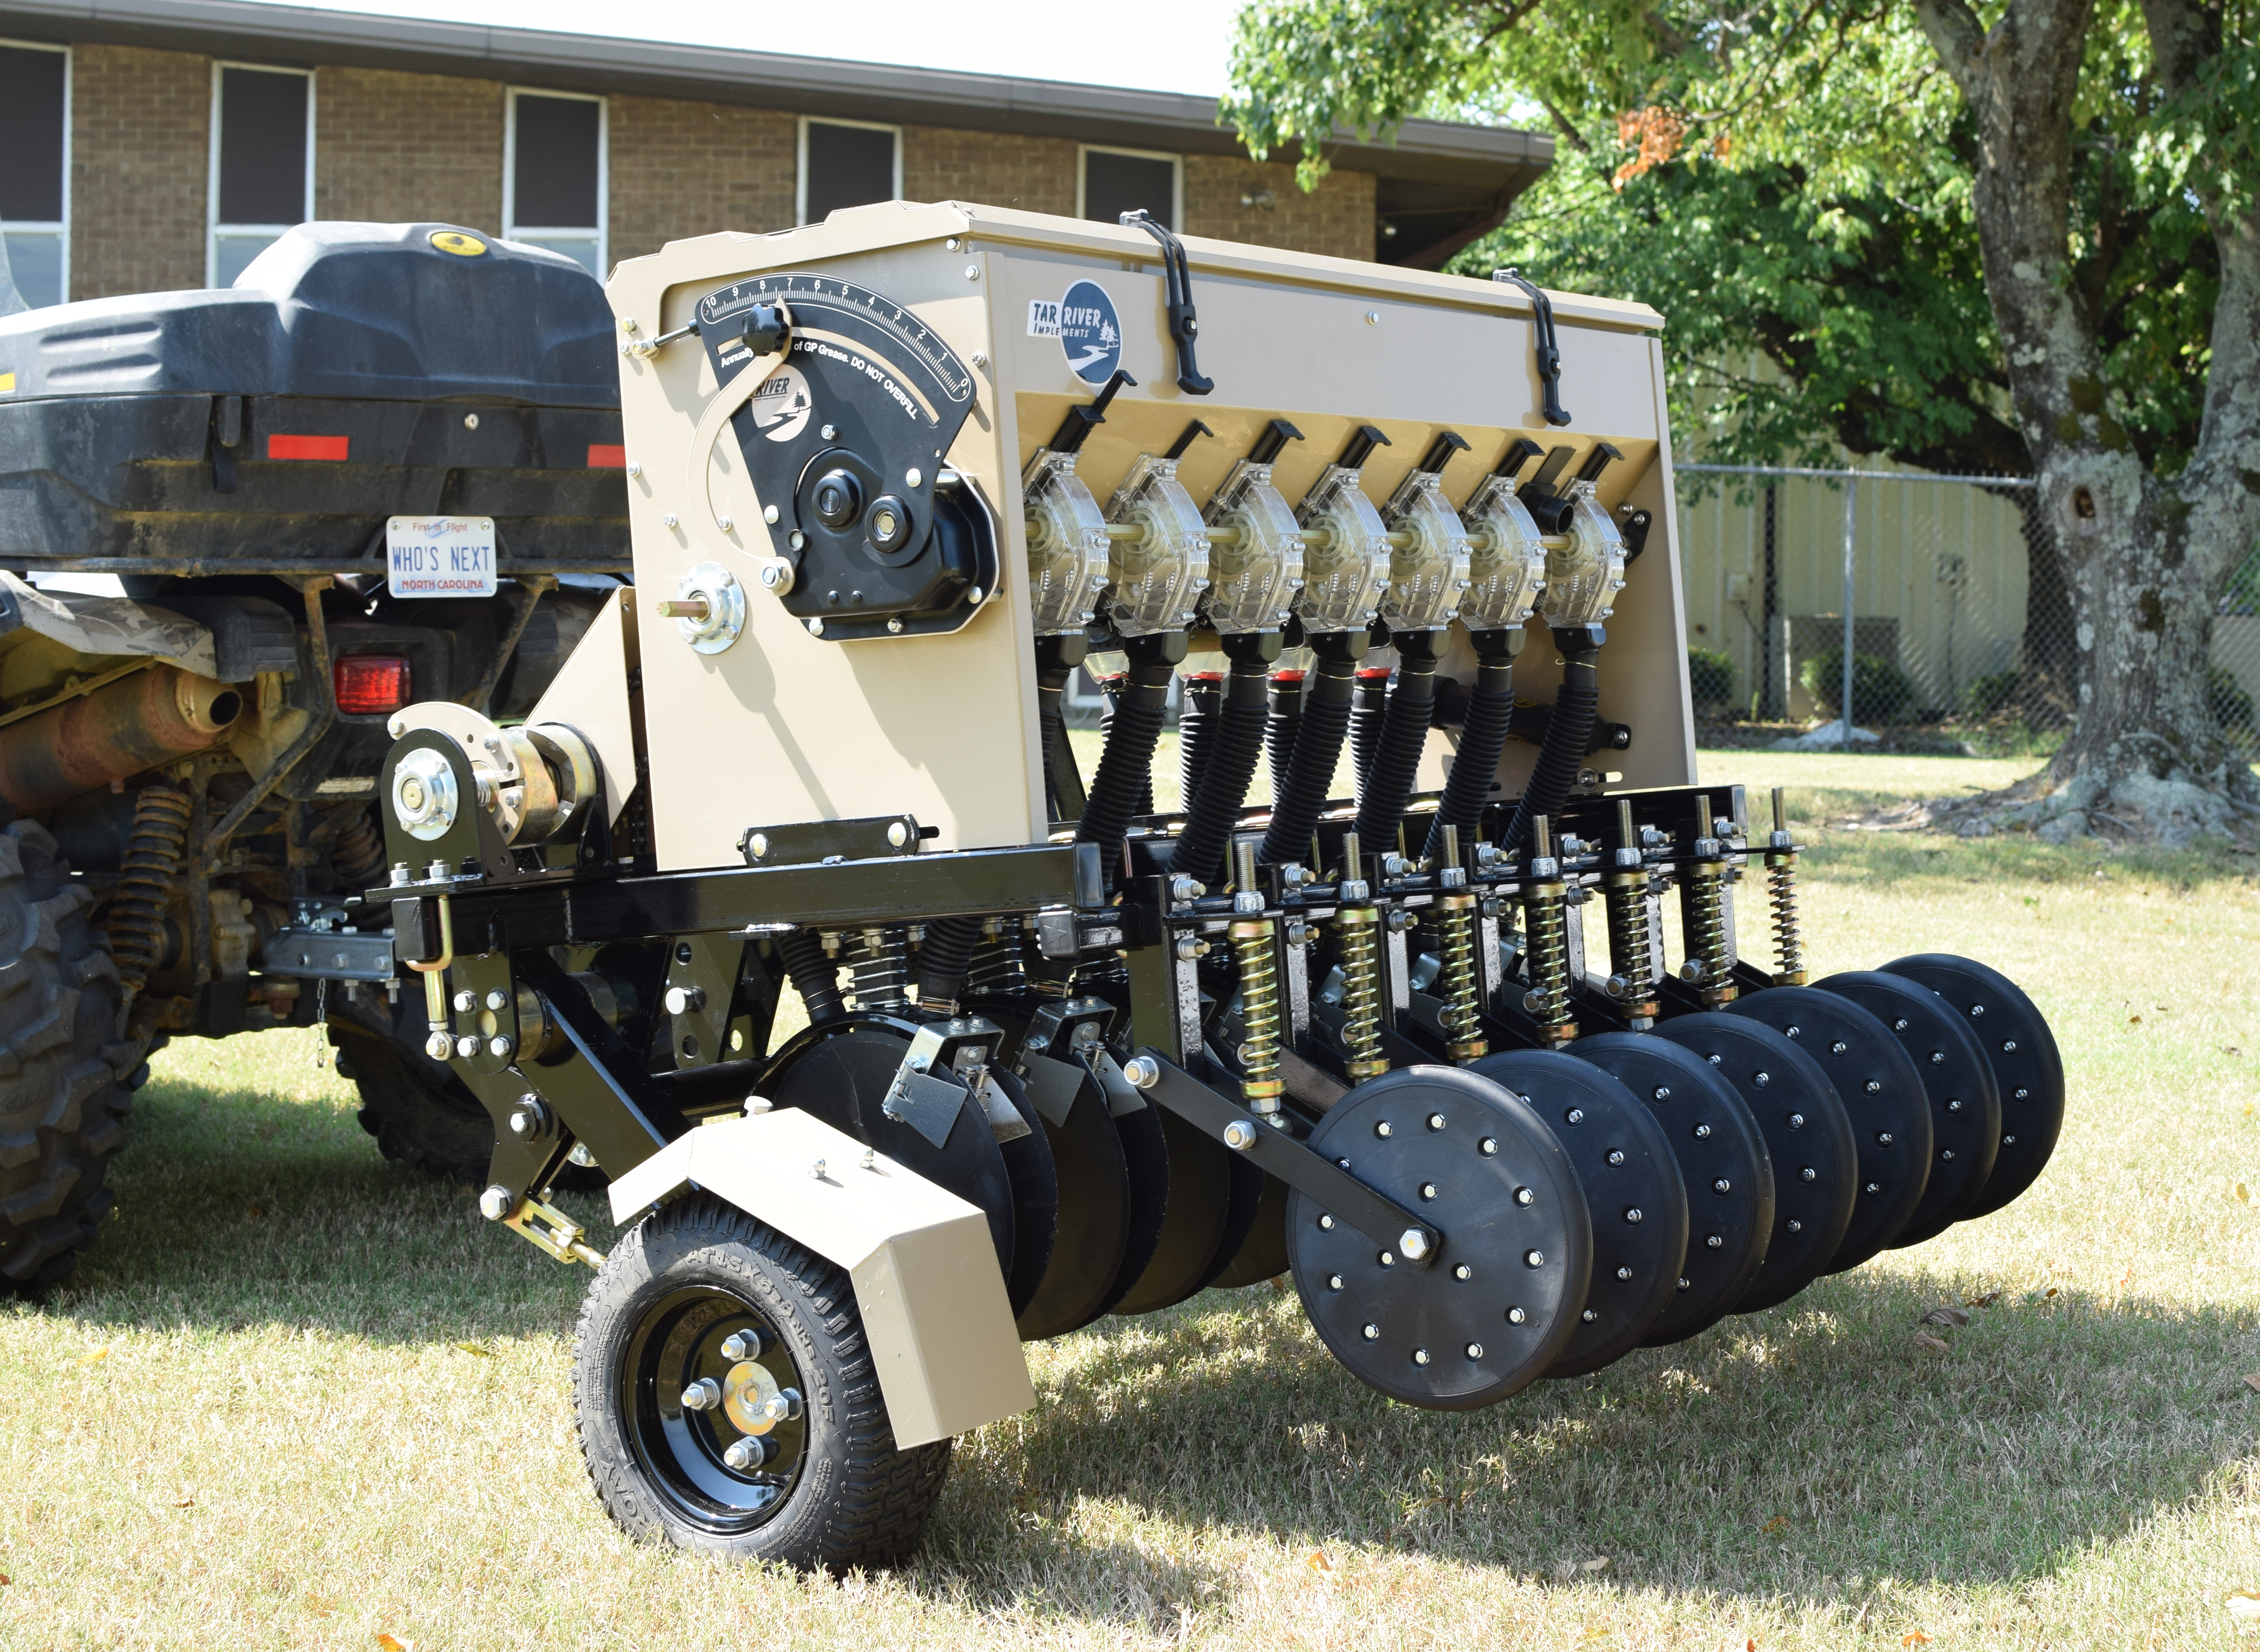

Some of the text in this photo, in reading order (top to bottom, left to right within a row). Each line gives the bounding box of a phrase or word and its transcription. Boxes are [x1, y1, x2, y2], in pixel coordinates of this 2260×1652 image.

[1034, 303, 1101, 329] TAR RIVER
[705, 277, 969, 387] 10 9 8 7 6 5 4 3 2 1 0
[721, 347, 754, 368] Annually
[794, 341, 917, 420] of GP Grease. DO NOT OVERFILL
[413, 523, 430, 531] First
[447, 523, 467, 532] Flight
[392, 546, 490, 572] WHO'S NEXT
[402, 580, 484, 590] NORTH CAROLINA
